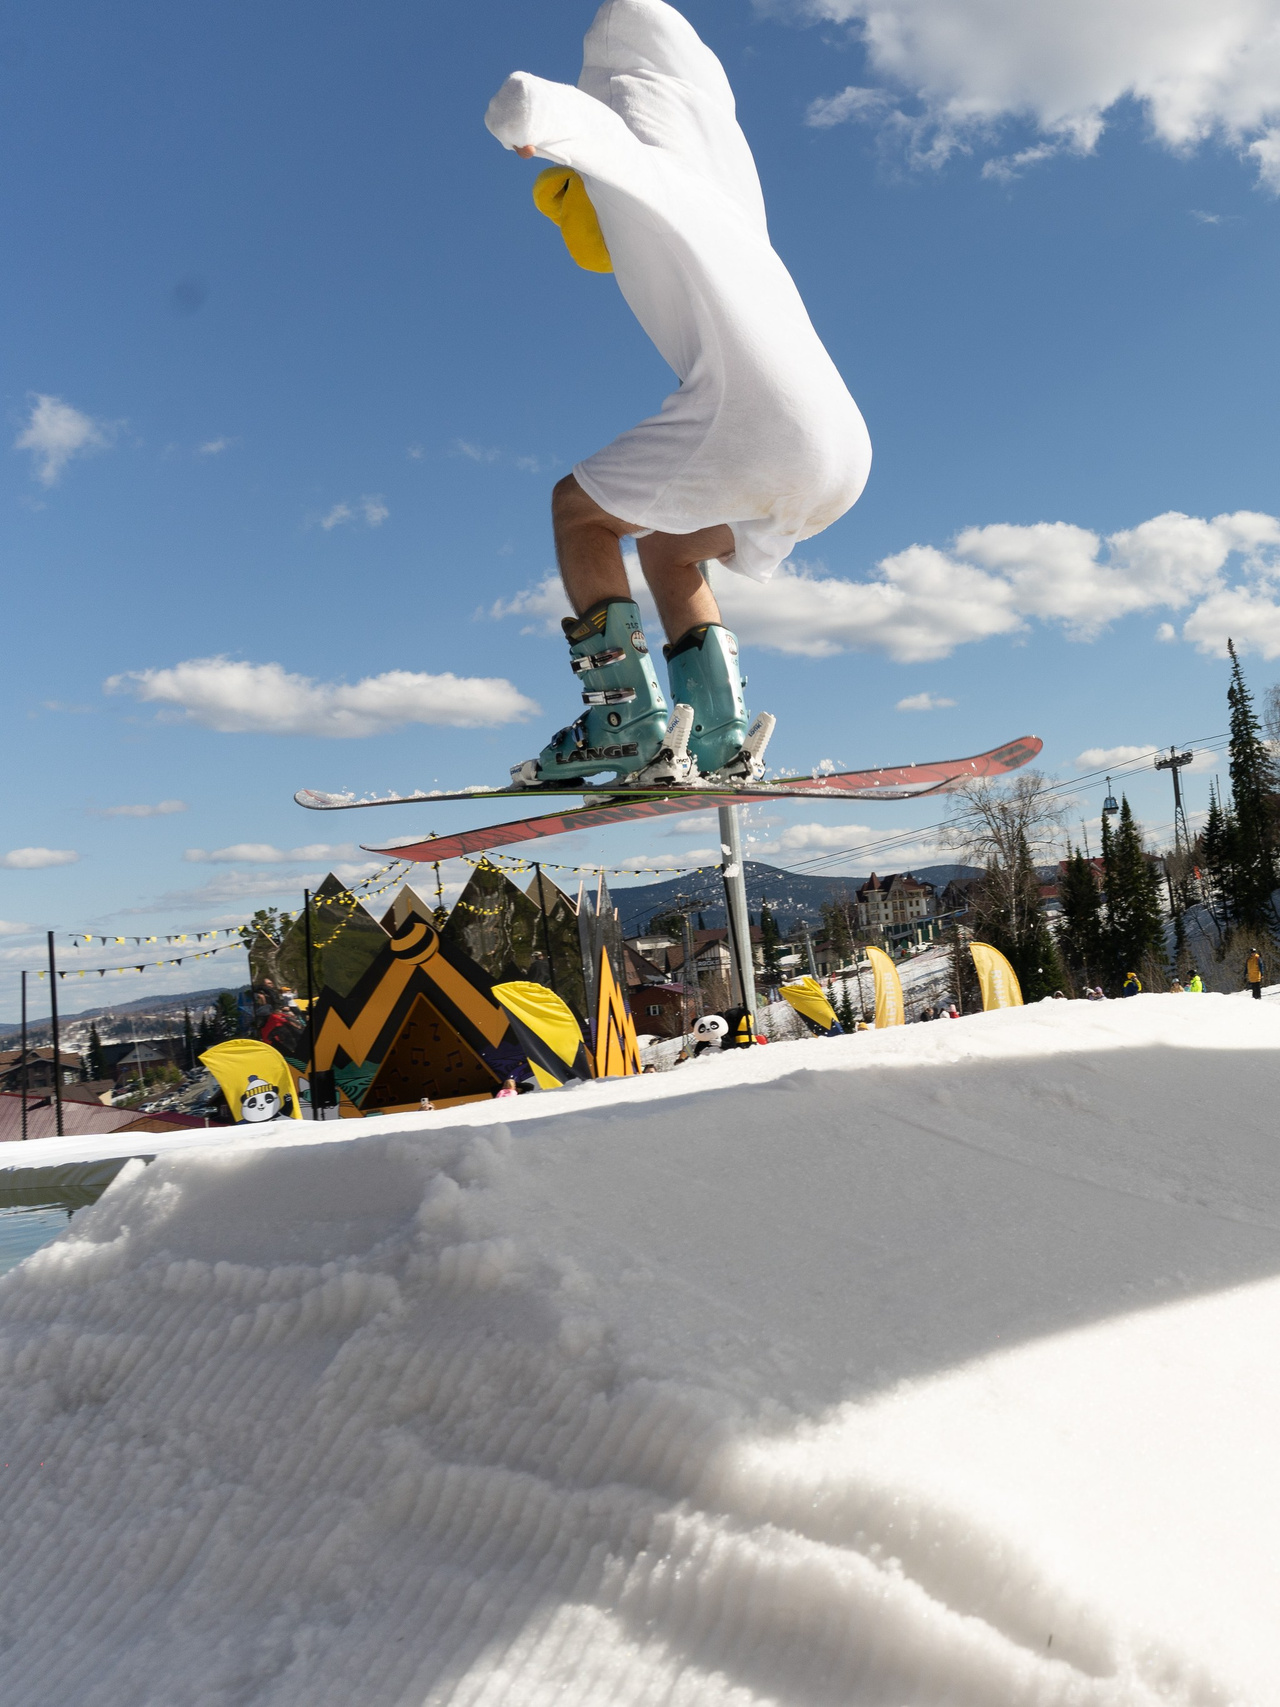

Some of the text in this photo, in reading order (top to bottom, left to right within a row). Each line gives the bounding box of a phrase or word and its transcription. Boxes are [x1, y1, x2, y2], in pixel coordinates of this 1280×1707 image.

[666, 716, 681, 734] LOOK
[747, 721, 763, 738] LOOK
[555, 741, 639, 765] LANGE
